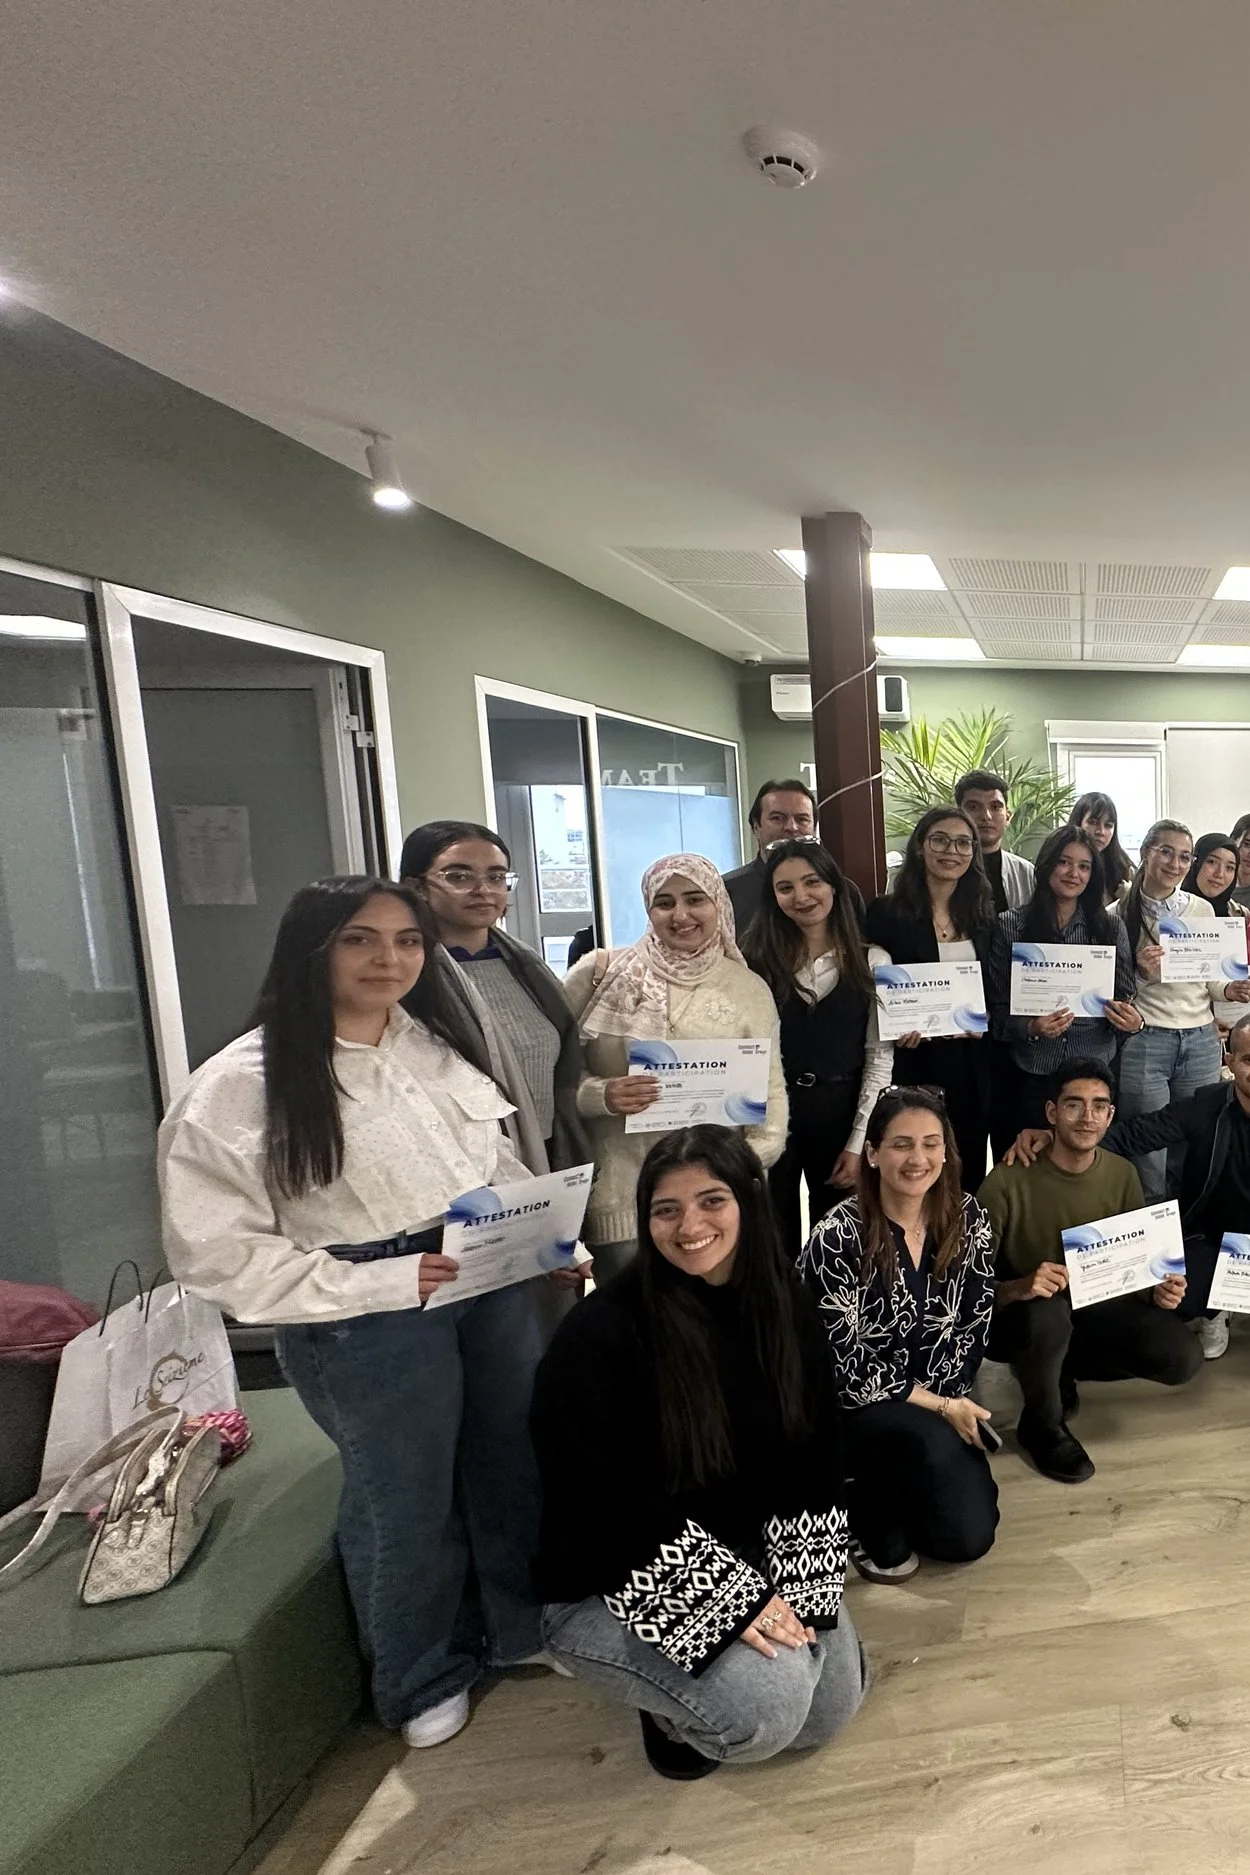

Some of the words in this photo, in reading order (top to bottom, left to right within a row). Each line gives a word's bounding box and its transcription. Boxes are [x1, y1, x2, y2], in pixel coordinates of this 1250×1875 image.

[1022, 961, 1083, 969] ATTESTATION
[887, 980, 950, 990] ATTESTATION
[643, 1061, 727, 1071] ATTESTATION
[463, 1200, 551, 1228] ATTESTATION
[1077, 1229, 1145, 1253] ATTESTATION
